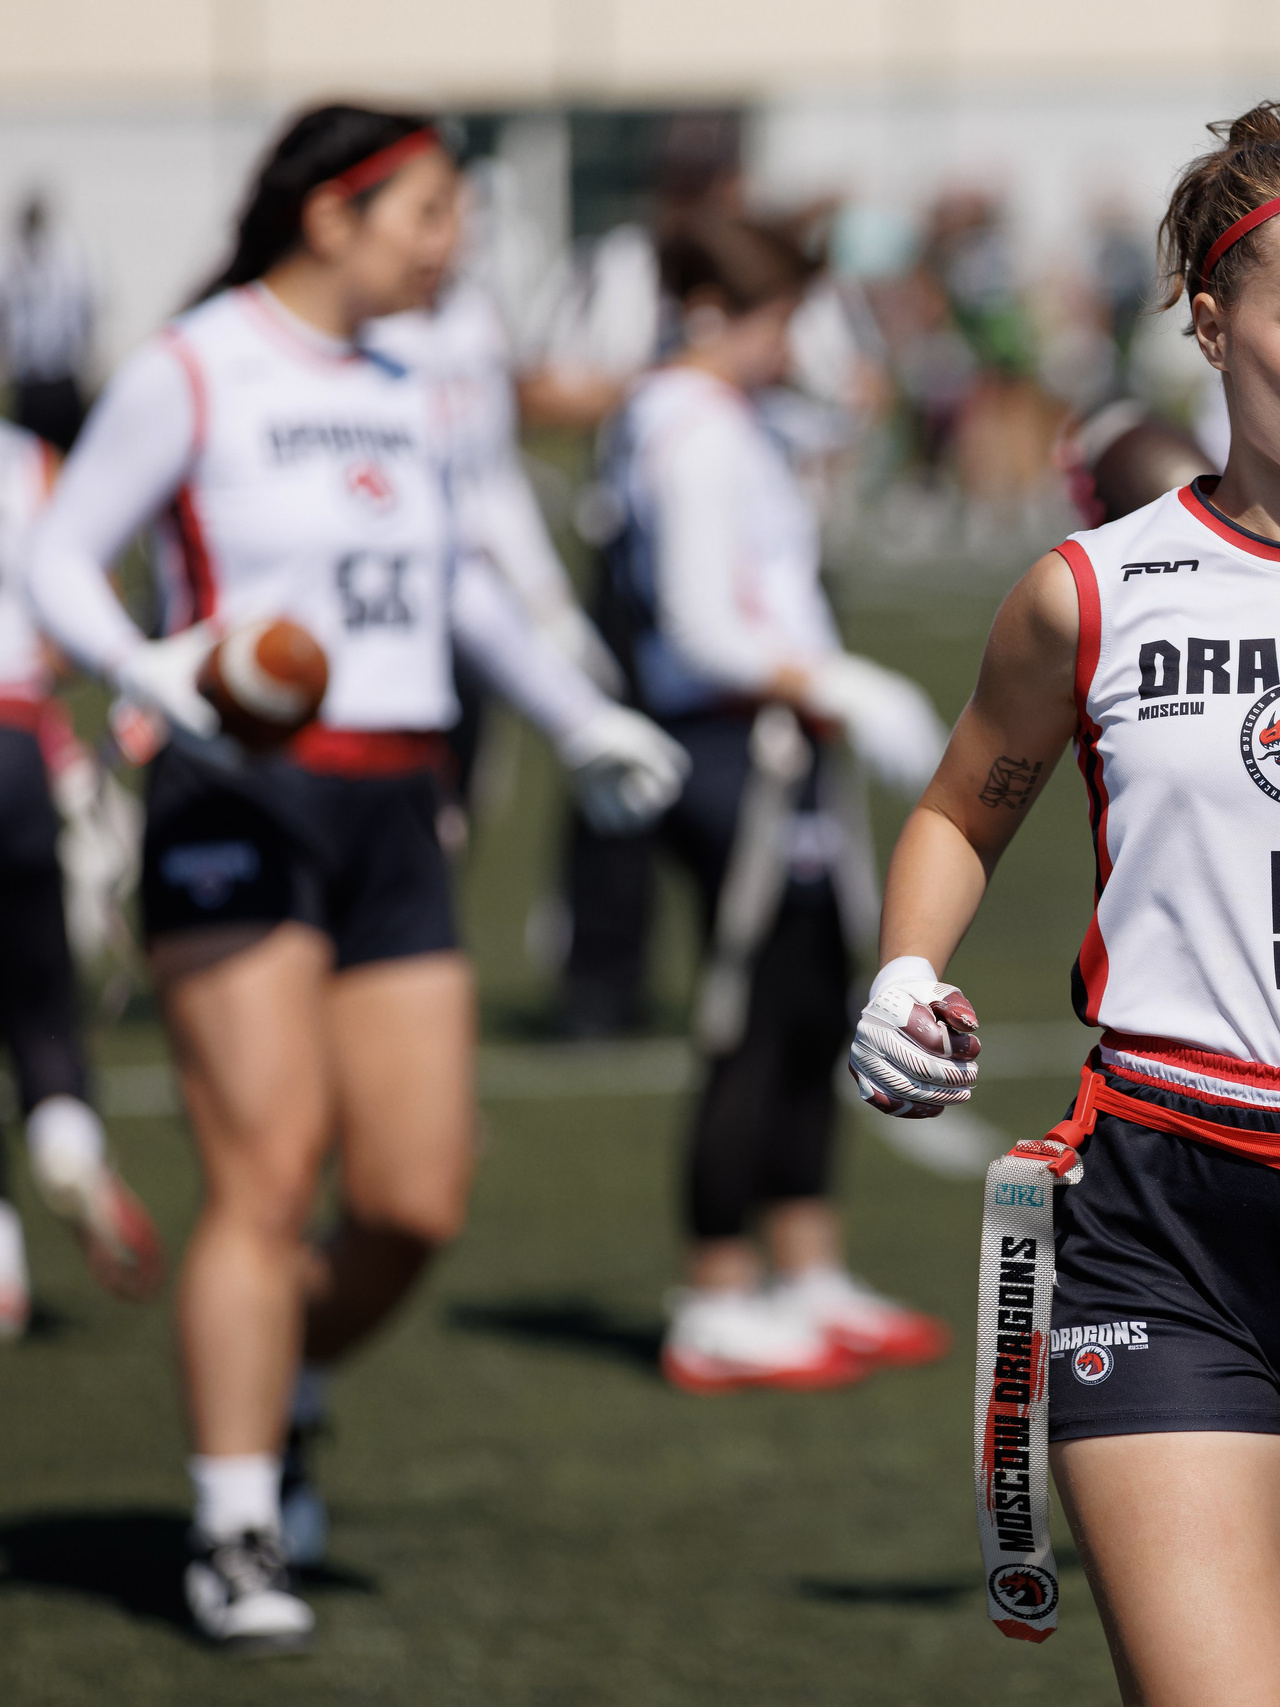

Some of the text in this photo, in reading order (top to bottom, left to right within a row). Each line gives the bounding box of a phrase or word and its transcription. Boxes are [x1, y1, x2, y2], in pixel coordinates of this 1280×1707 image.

[1138, 701, 1205, 721] MOSCOW
[993, 1235, 1037, 1405] DRAGONS
[1050, 1321, 1149, 1353] DRAGONS
[994, 1414, 1036, 1553] MOSCOW
